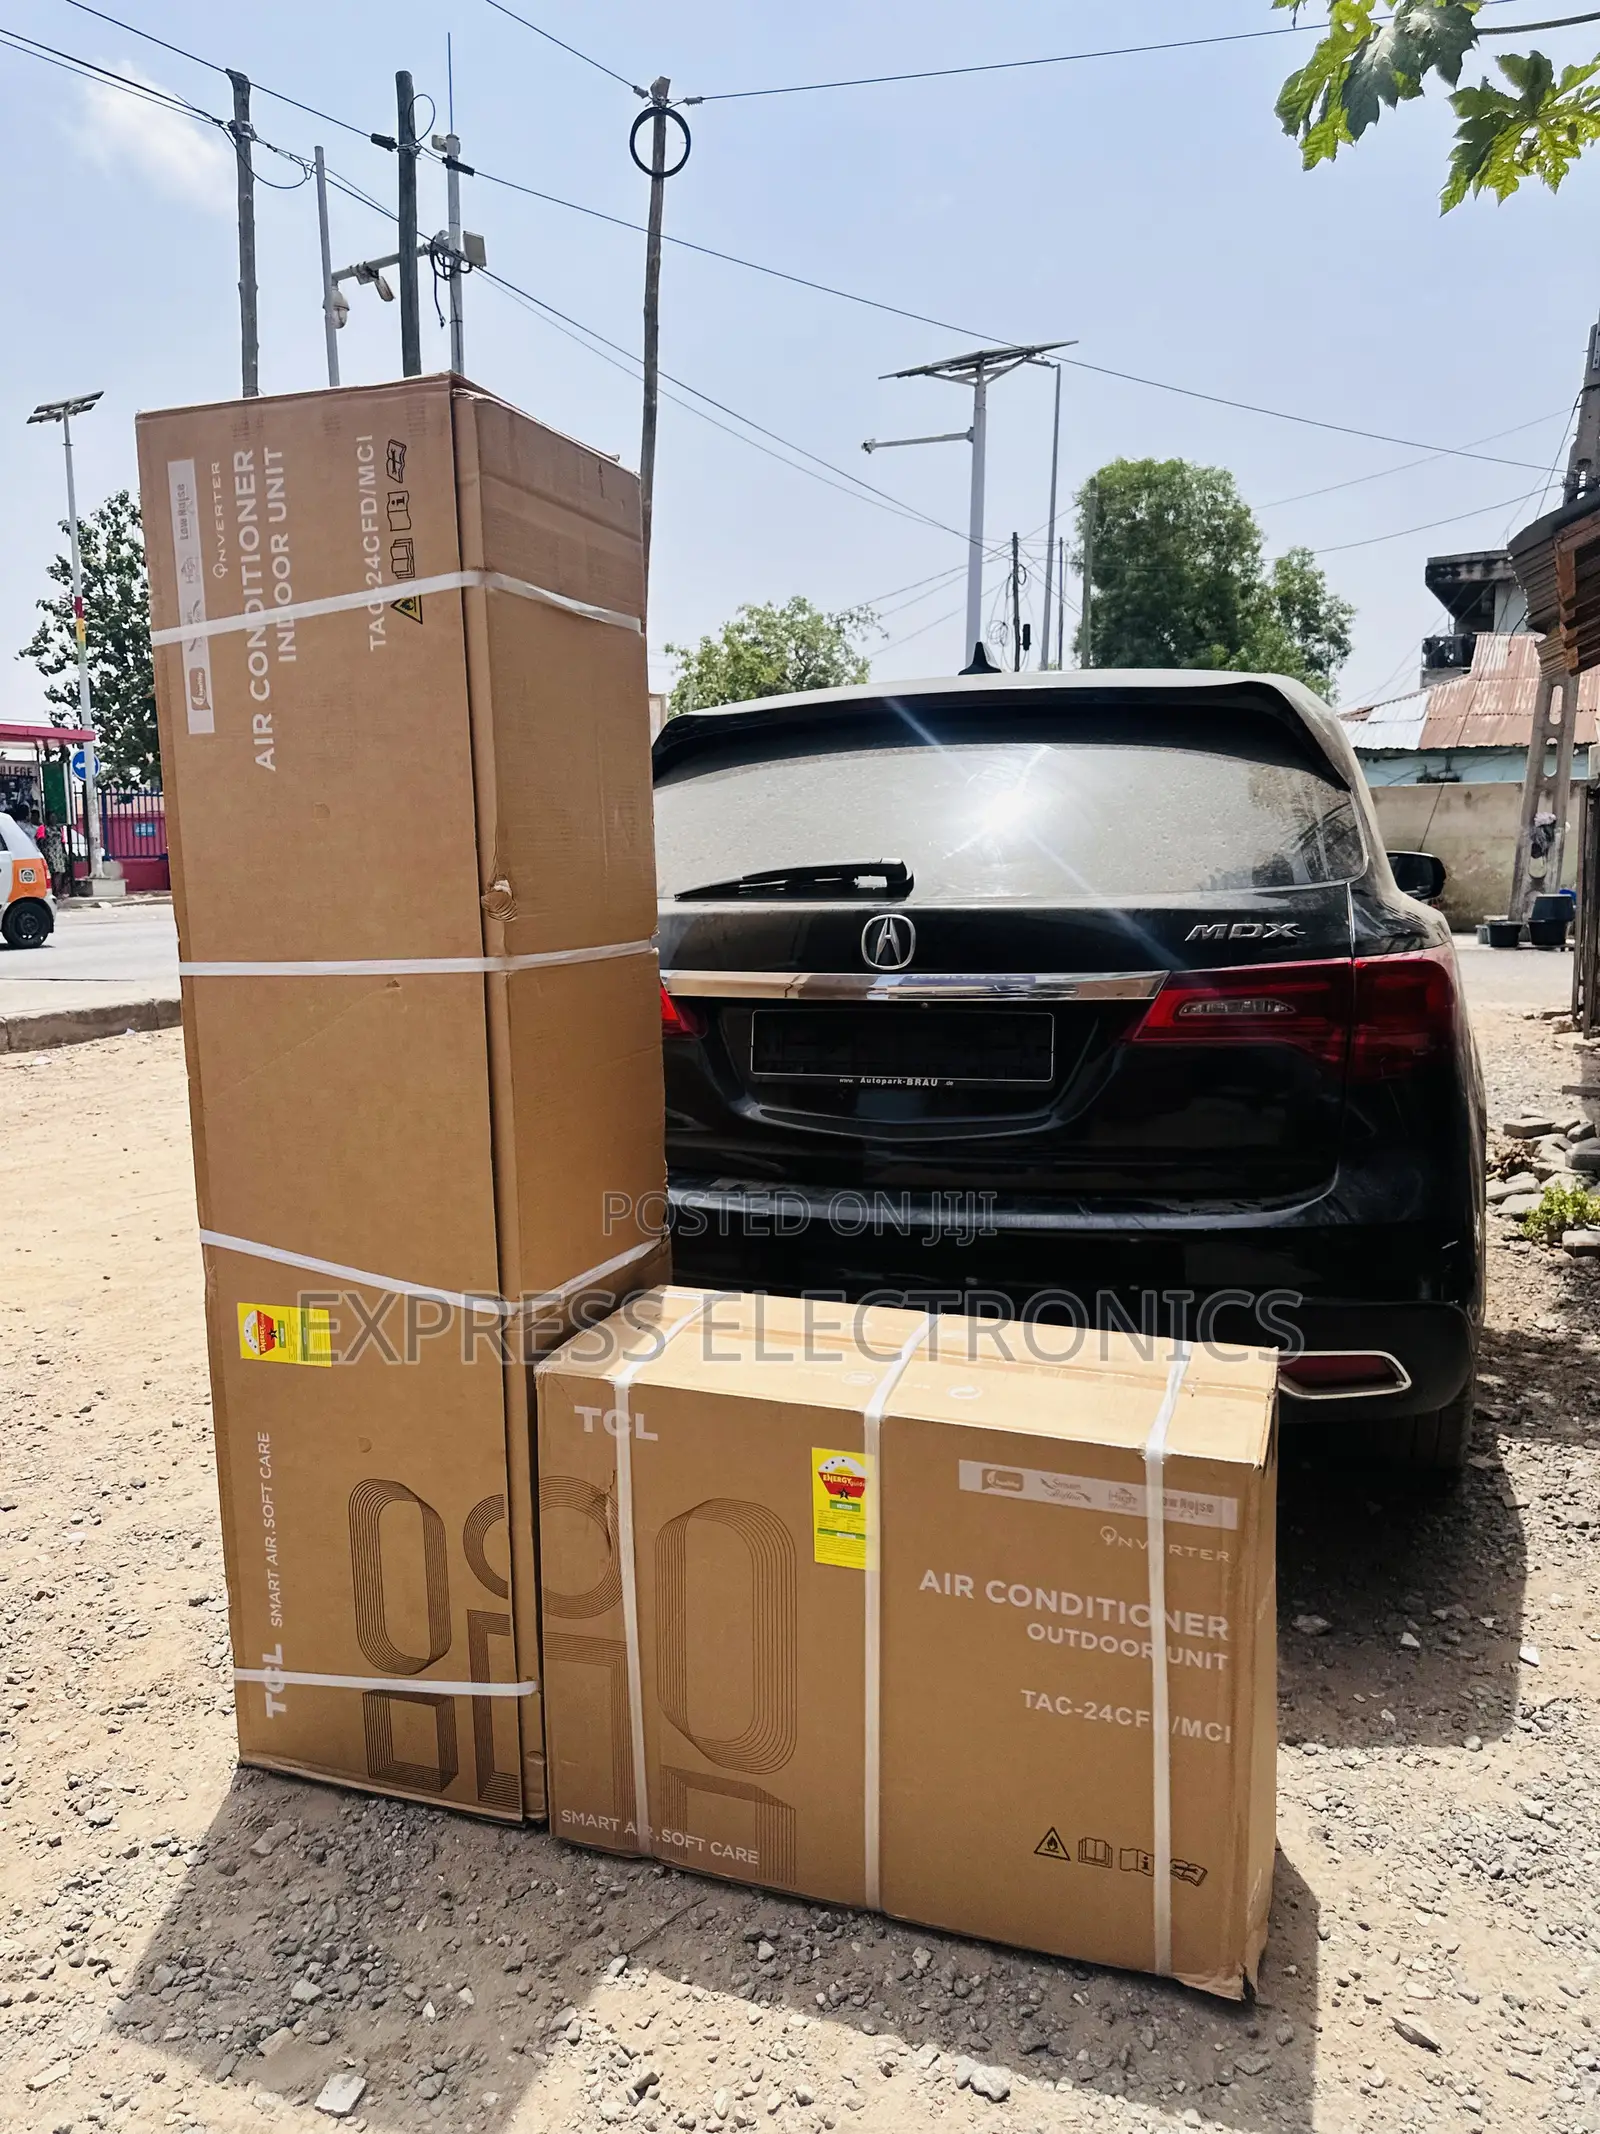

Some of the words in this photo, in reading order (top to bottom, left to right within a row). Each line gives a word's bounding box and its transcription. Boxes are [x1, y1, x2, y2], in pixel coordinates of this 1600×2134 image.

[264, 447, 287, 522] UNIT
[233, 449, 271, 702] CONDITIONER
[252, 712, 276, 772] AIR
[1185, 922, 1300, 942] MDX
[574, 1405, 658, 1441] TCL
[257, 1432, 272, 1479] CARE
[822, 1474, 852, 1485] ENERGY
[260, 1482, 276, 1529] SOFT
[267, 1569, 283, 1628] SMART
[919, 1569, 974, 1599] AIR
[985, 1580, 1229, 1641] CONDITIONER
[1027, 1623, 1153, 1659] OUTDOOR
[1167, 1646, 1229, 1671] UNIT
[1020, 1689, 1231, 1745] TAC-24CF/MCI
[560, 1809, 620, 1832] SMART
[624, 1821, 660, 1842] AR,
[661, 1828, 706, 1852] SOFT
[710, 1842, 760, 1865] CARE
